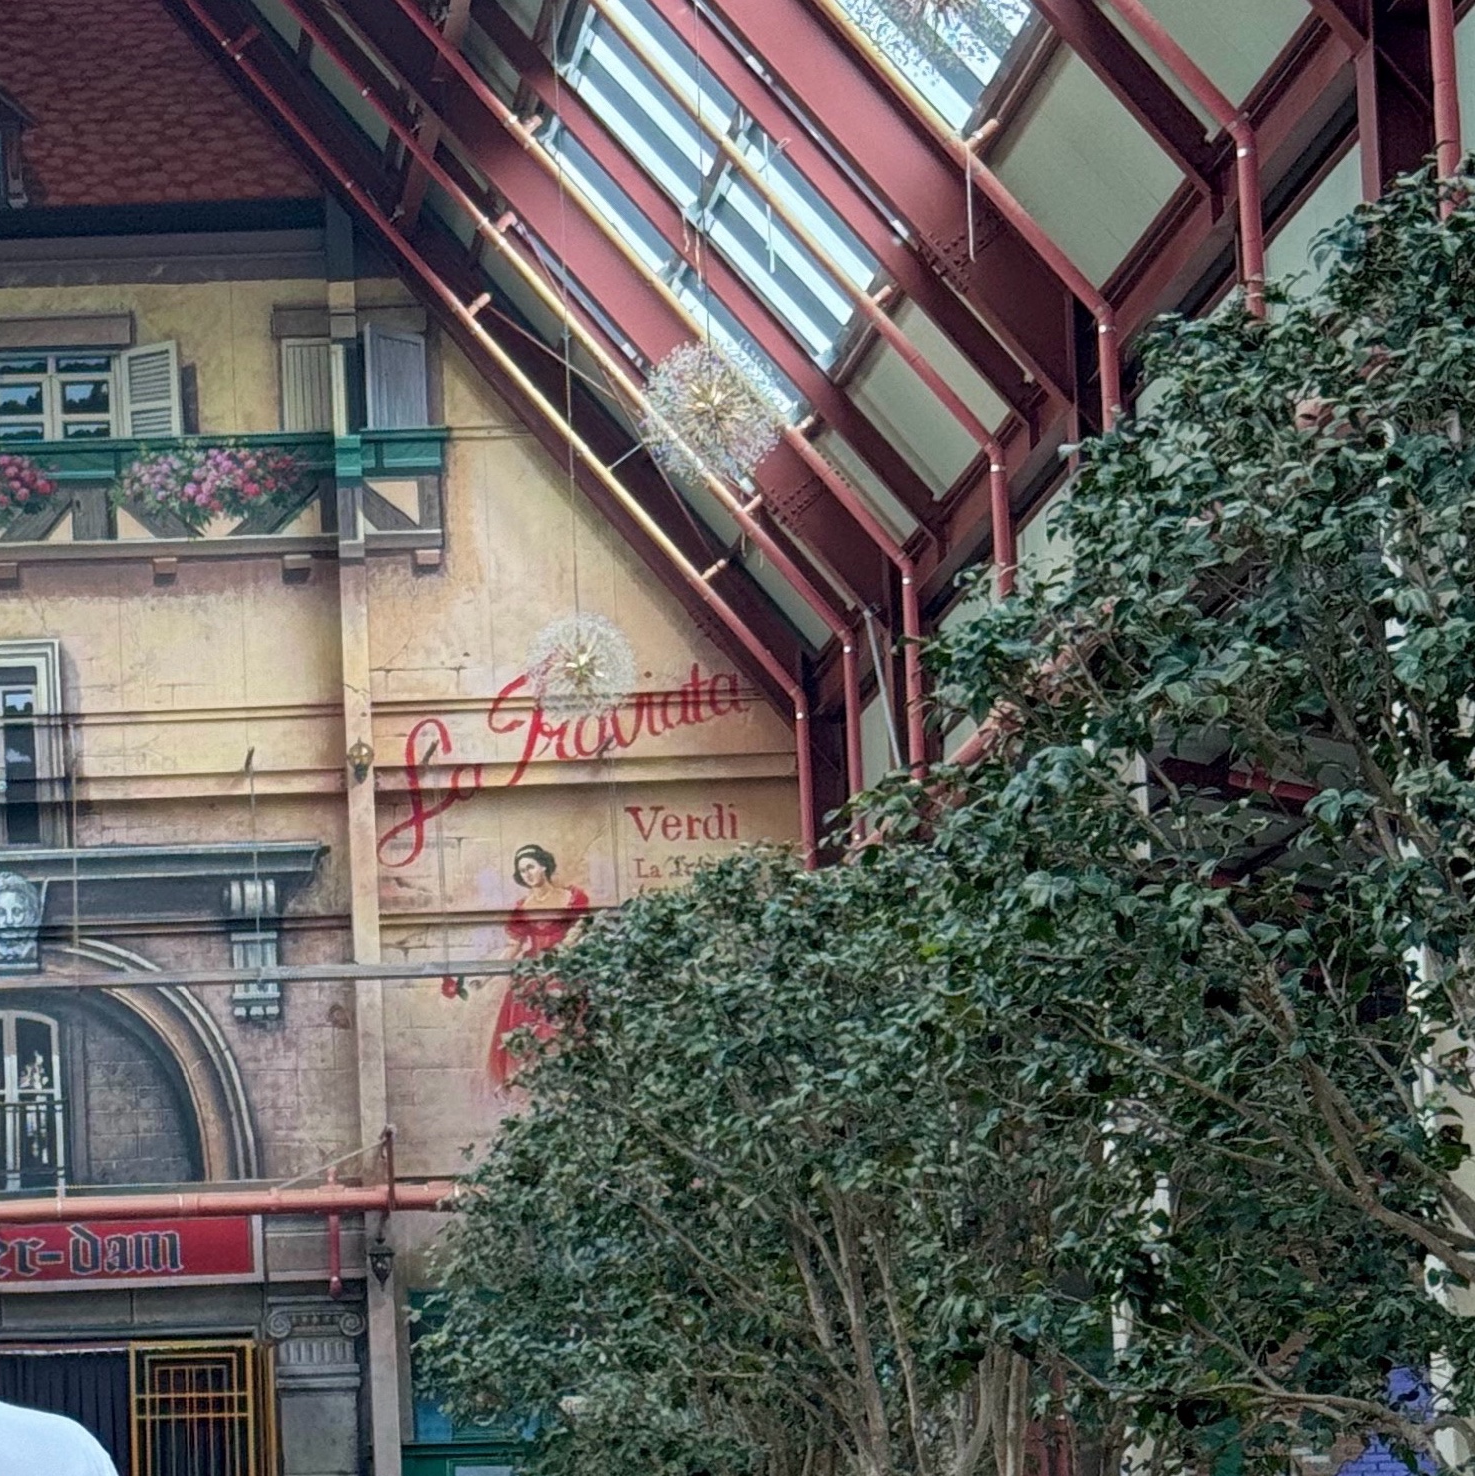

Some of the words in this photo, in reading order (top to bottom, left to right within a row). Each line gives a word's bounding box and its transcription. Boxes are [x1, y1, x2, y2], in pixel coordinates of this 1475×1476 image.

[376, 718, 481, 868] La
[625, 803, 738, 842] Verdi
[633, 858, 662, 878] La
